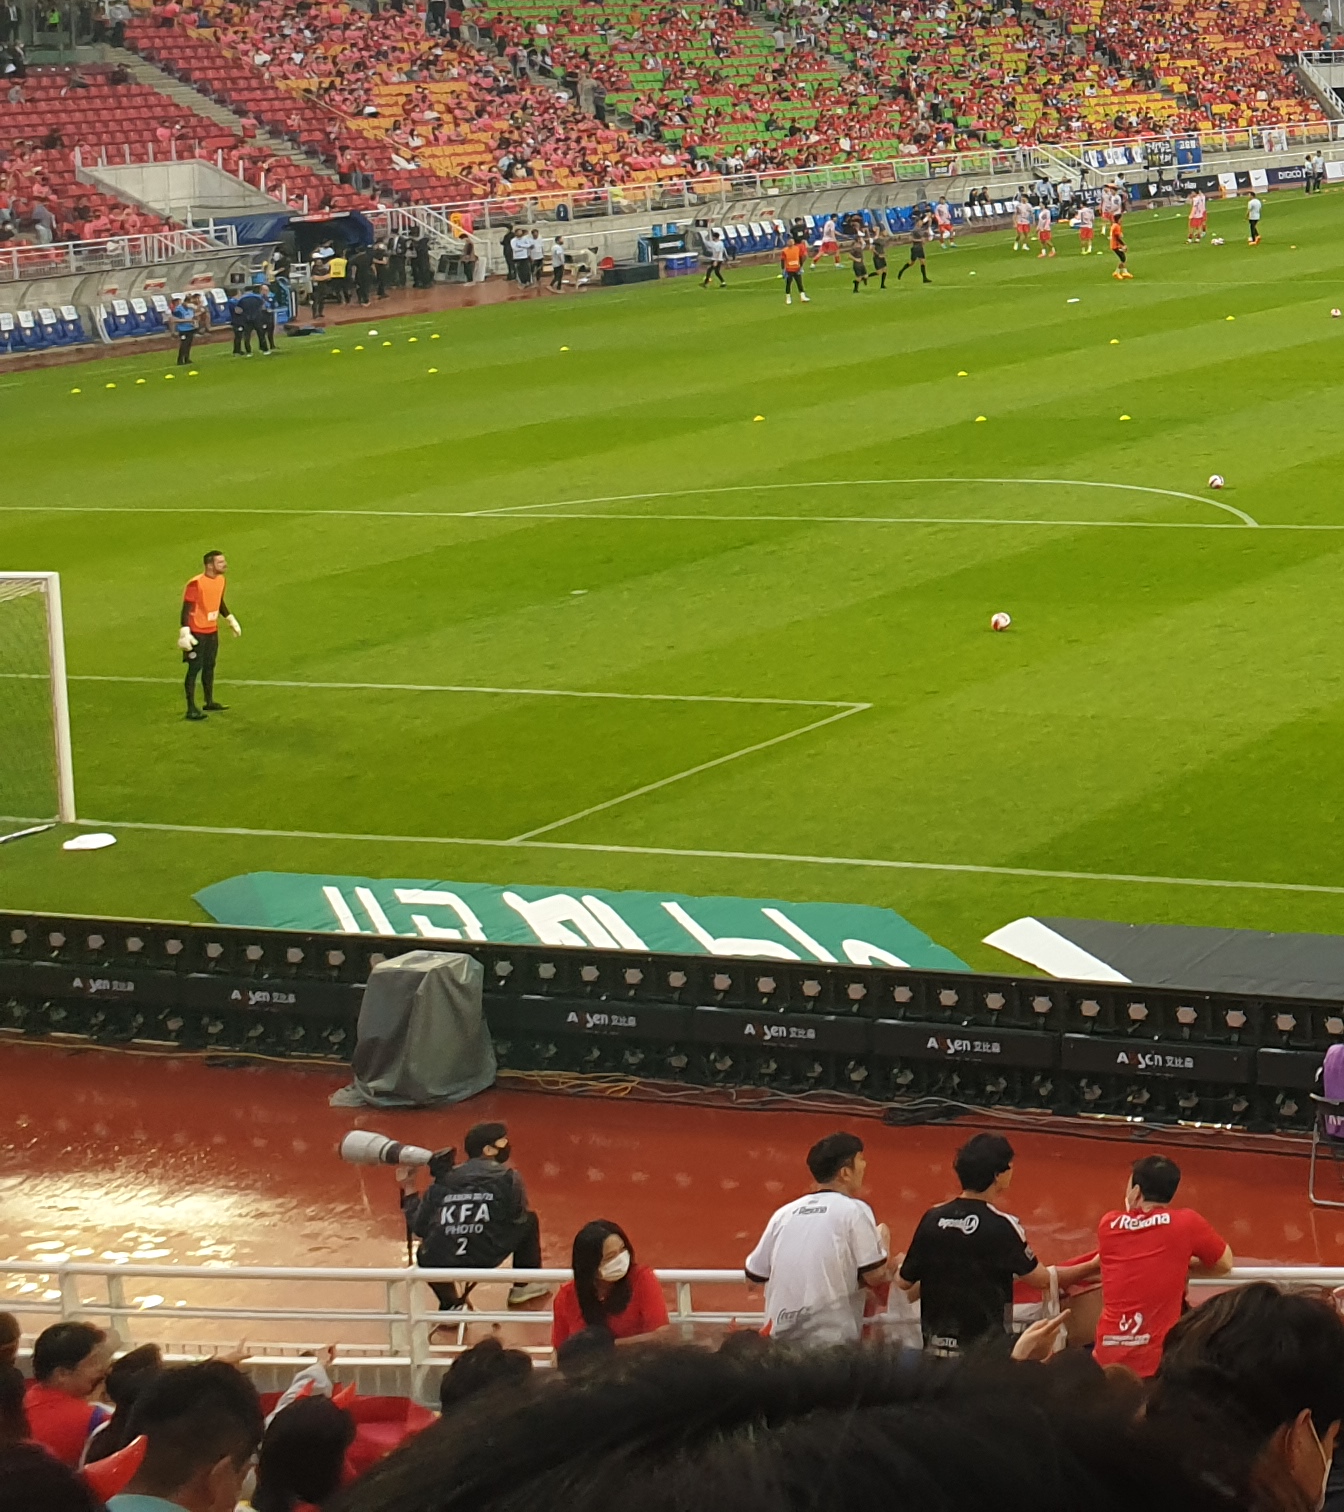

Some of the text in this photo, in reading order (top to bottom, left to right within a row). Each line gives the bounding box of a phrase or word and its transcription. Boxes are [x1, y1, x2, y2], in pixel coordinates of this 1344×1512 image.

[1278, 169, 1301, 180] DIGICO
[73, 978, 110, 992] Asen
[230, 989, 270, 1005] Asen
[567, 1011, 608, 1028] Asen
[744, 1023, 787, 1040] Asen
[441, 1203, 490, 1225] KFA
[1119, 1213, 1170, 1230] Rexona
[445, 1224, 483, 1235] PHOTO
[455, 1238, 468, 1255] 2
